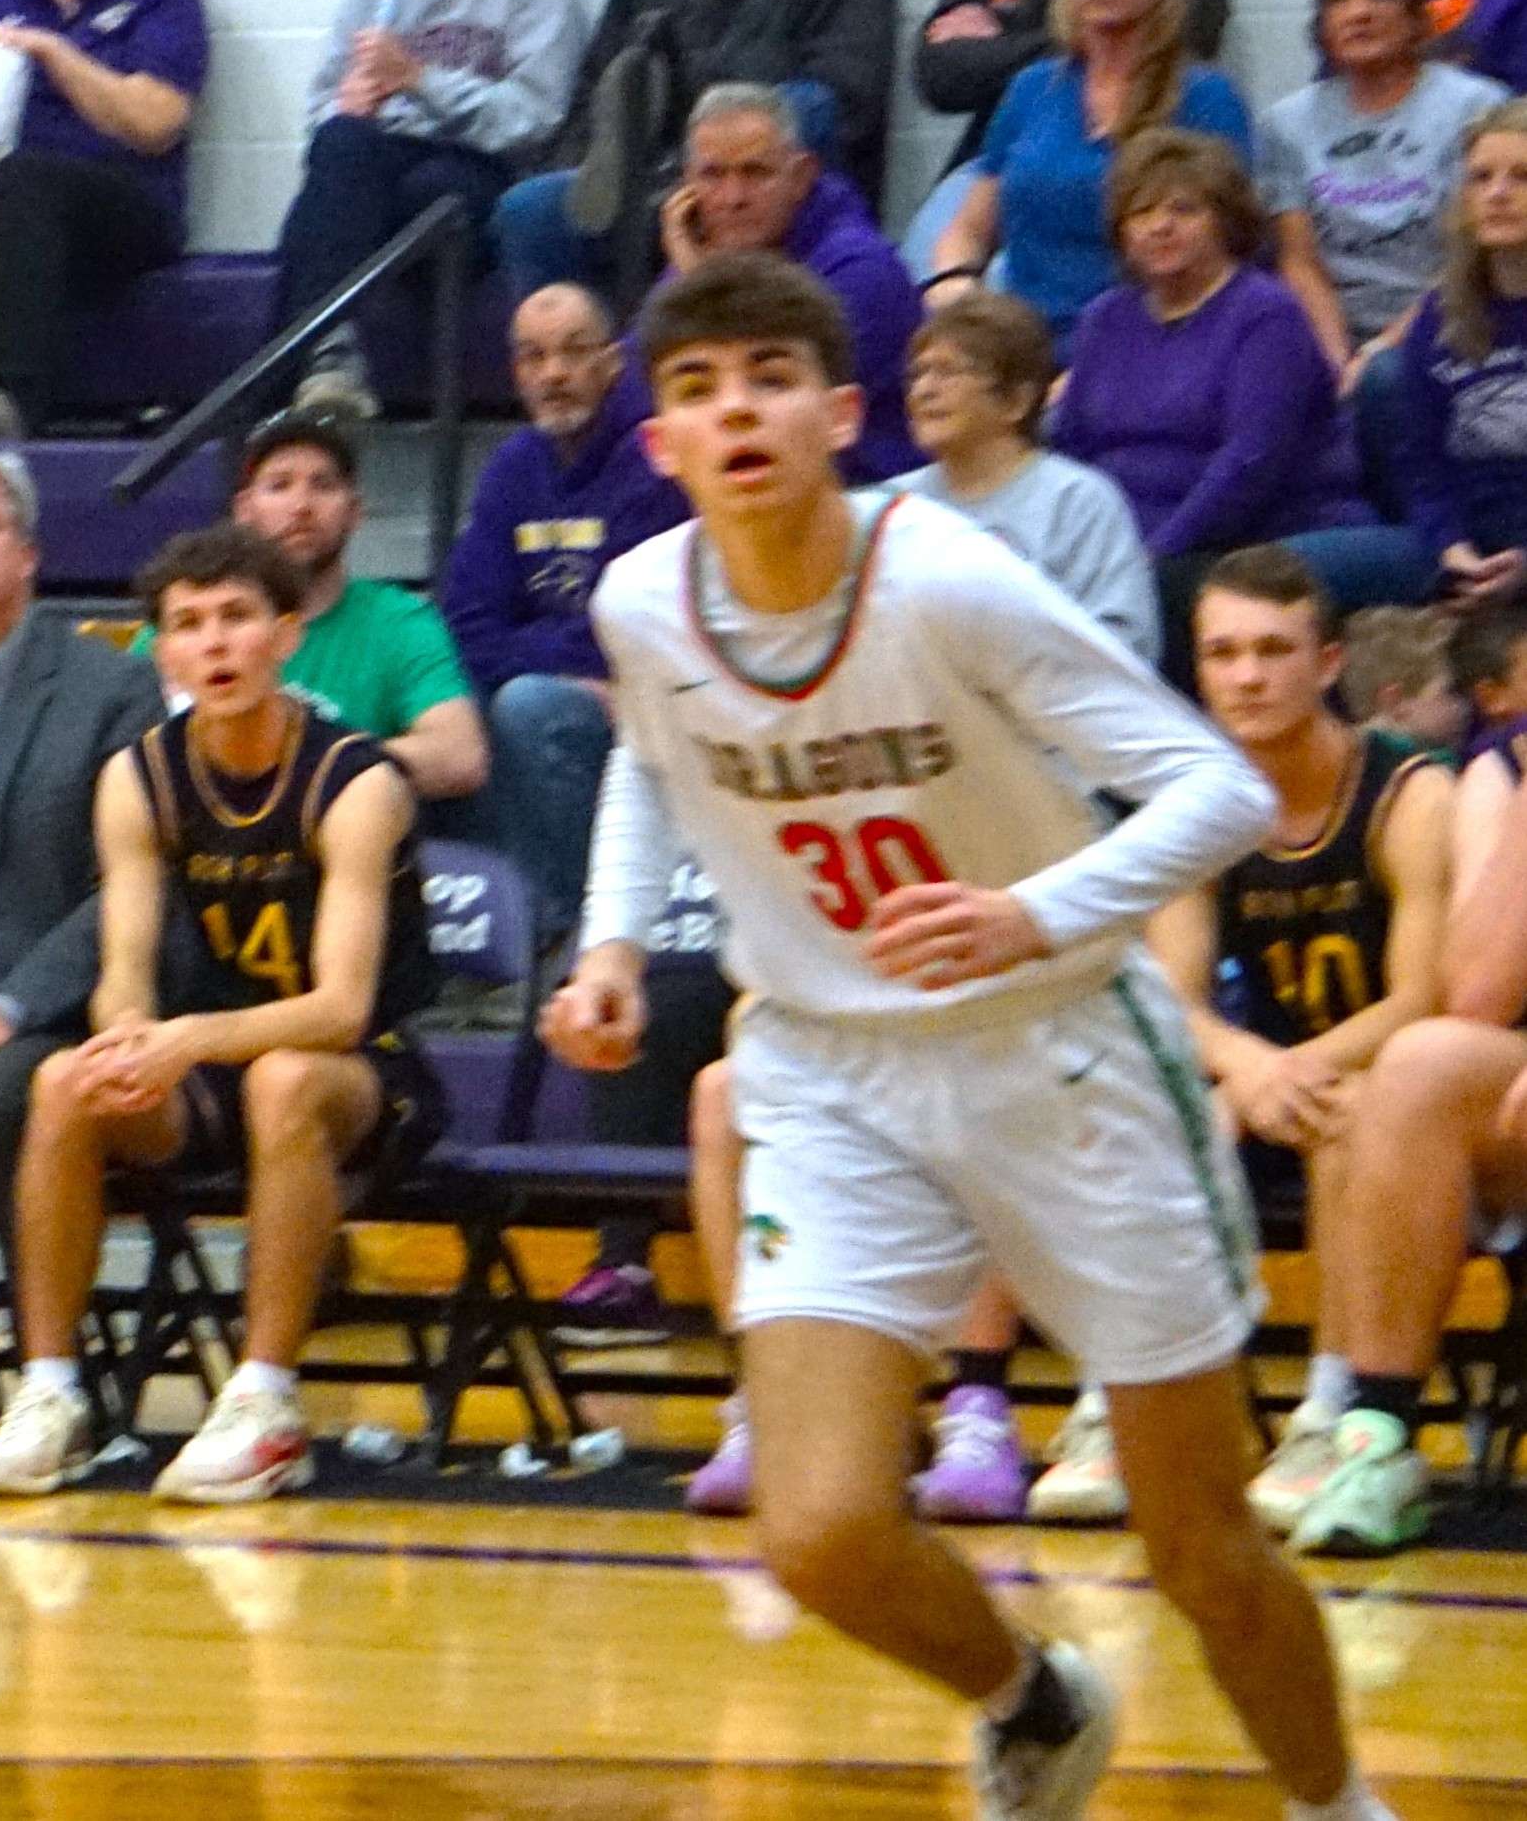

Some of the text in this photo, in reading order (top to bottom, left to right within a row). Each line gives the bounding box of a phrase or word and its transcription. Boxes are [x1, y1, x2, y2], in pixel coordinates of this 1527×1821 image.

[776, 814, 950, 933] 30
[201, 900, 304, 999] 14
[1262, 933, 1368, 1031] 10
